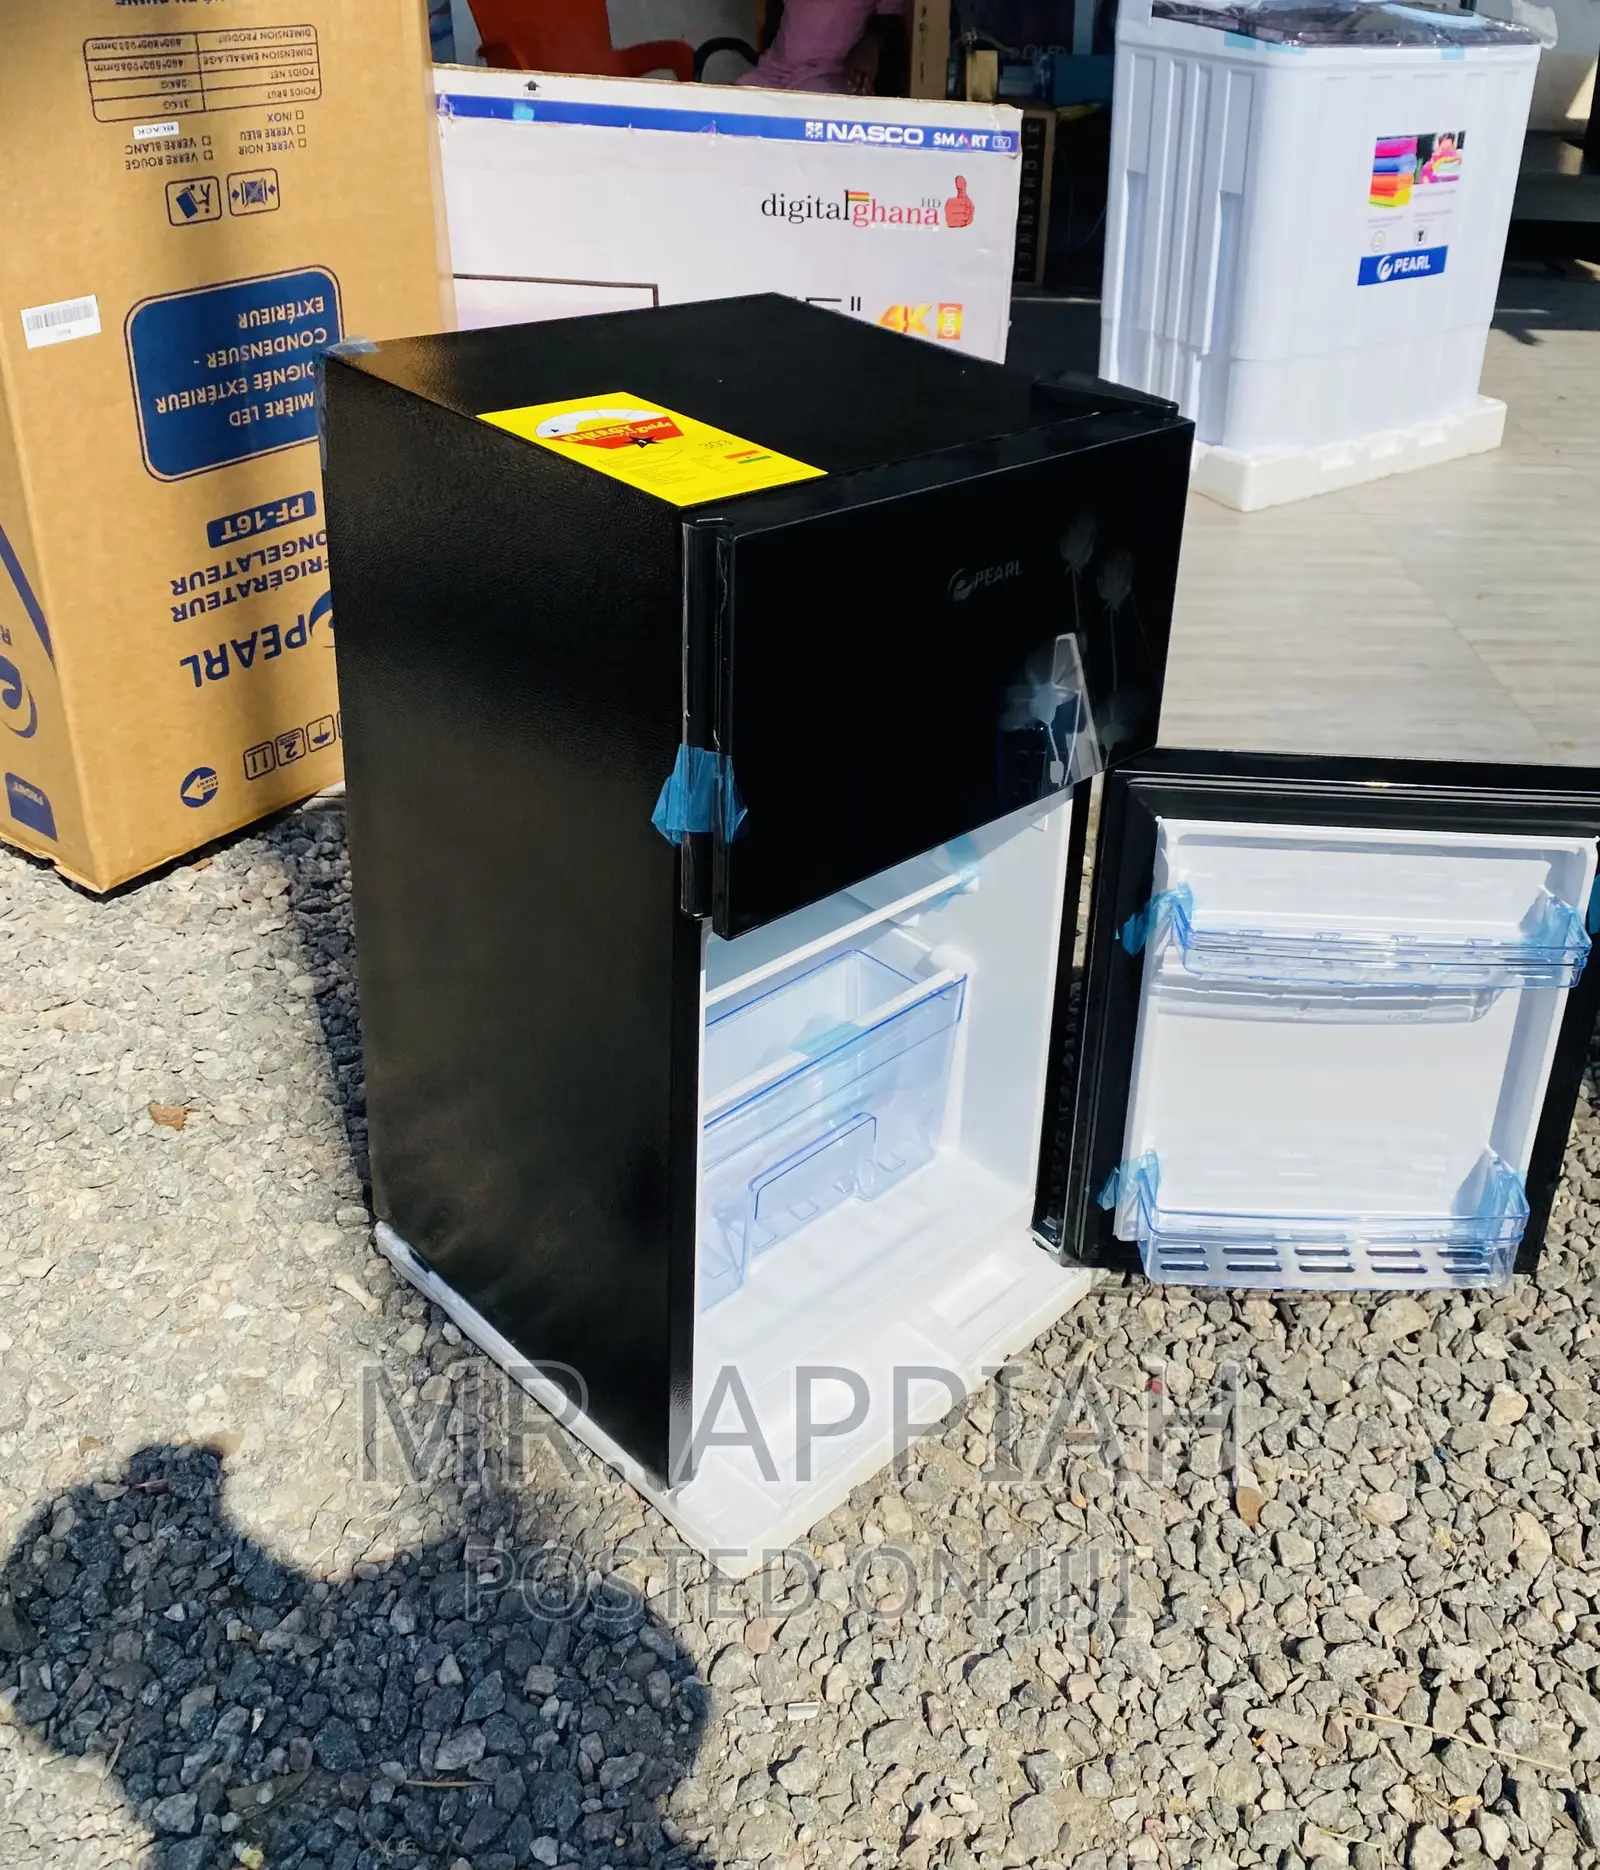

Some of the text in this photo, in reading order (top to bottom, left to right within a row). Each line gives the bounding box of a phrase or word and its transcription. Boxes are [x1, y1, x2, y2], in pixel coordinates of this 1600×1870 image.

[260, 29, 311, 40] DIMENSION
[262, 48, 313, 60] DIMENSION
[289, 67, 314, 78] POIDS
[291, 86, 316, 98] POIDS
[267, 112, 292, 123] INOX
[137, 123, 175, 136] BLACK
[240, 126, 294, 141] VERRE BLEU
[826, 123, 1010, 149] NASCO SMART TV
[124, 137, 197, 154] VERRE BLANC
[238, 140, 295, 155] VERRE NOIR
[125, 152, 198, 170] VERRE ROUGE
[921, 197, 941, 209] HD
[1017, 160, 1039, 276] CHANNEL
[1394, 255, 1431, 273] PEARL
[238, 296, 324, 329] EXTÉRIEUR
[877, 303, 932, 337] 4K
[942, 306, 957, 338] UHD
[206, 327, 328, 368] CONDENSUER
[155, 361, 315, 415] IGNÉE EXTÉRIEUR
[229, 392, 315, 427] MIÈRE LED
[561, 424, 633, 442] ENERGY
[220, 498, 306, 541] PF-16T
[169, 530, 328, 597] ONGELATEUR
[974, 560, 1022, 588] PEARL
[170, 555, 328, 623] RIGÉRATEUR
[179, 614, 308, 688] PEARL
